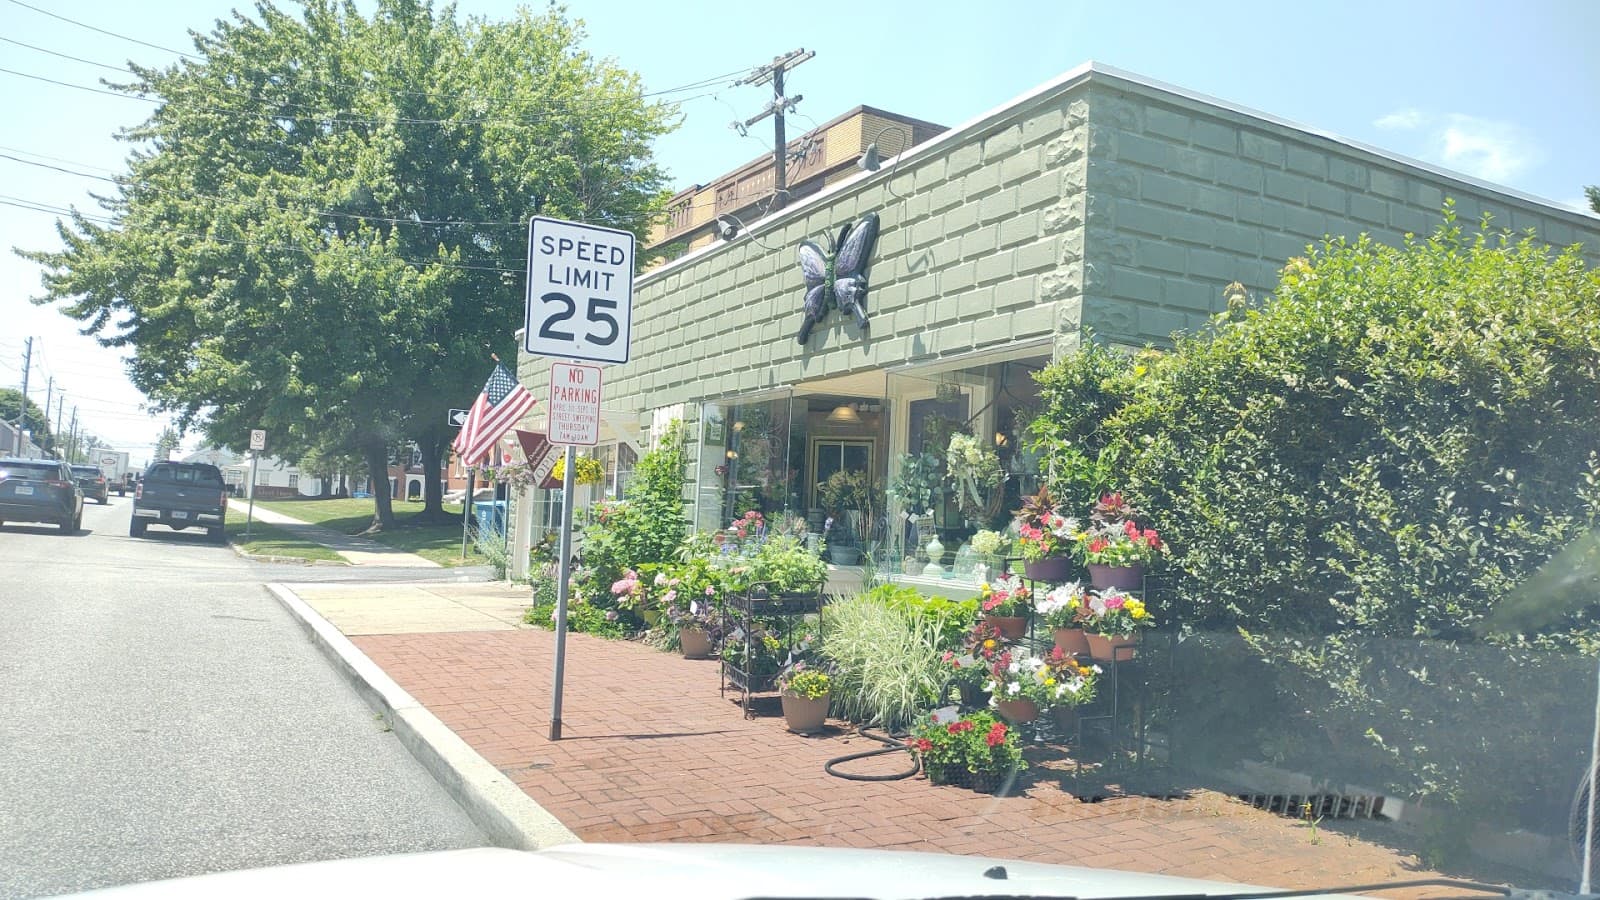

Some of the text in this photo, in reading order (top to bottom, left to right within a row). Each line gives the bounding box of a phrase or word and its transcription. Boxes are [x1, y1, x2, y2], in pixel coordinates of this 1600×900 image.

[540, 235, 625, 266] SPEED
[548, 264, 615, 292] LIMIT
[539, 292, 619, 346] 25
[568, 368, 584, 384] NO
[554, 386, 597, 404] PARKING
[552, 411, 570, 422] STREET
[558, 422, 590, 433] THURSDAY
